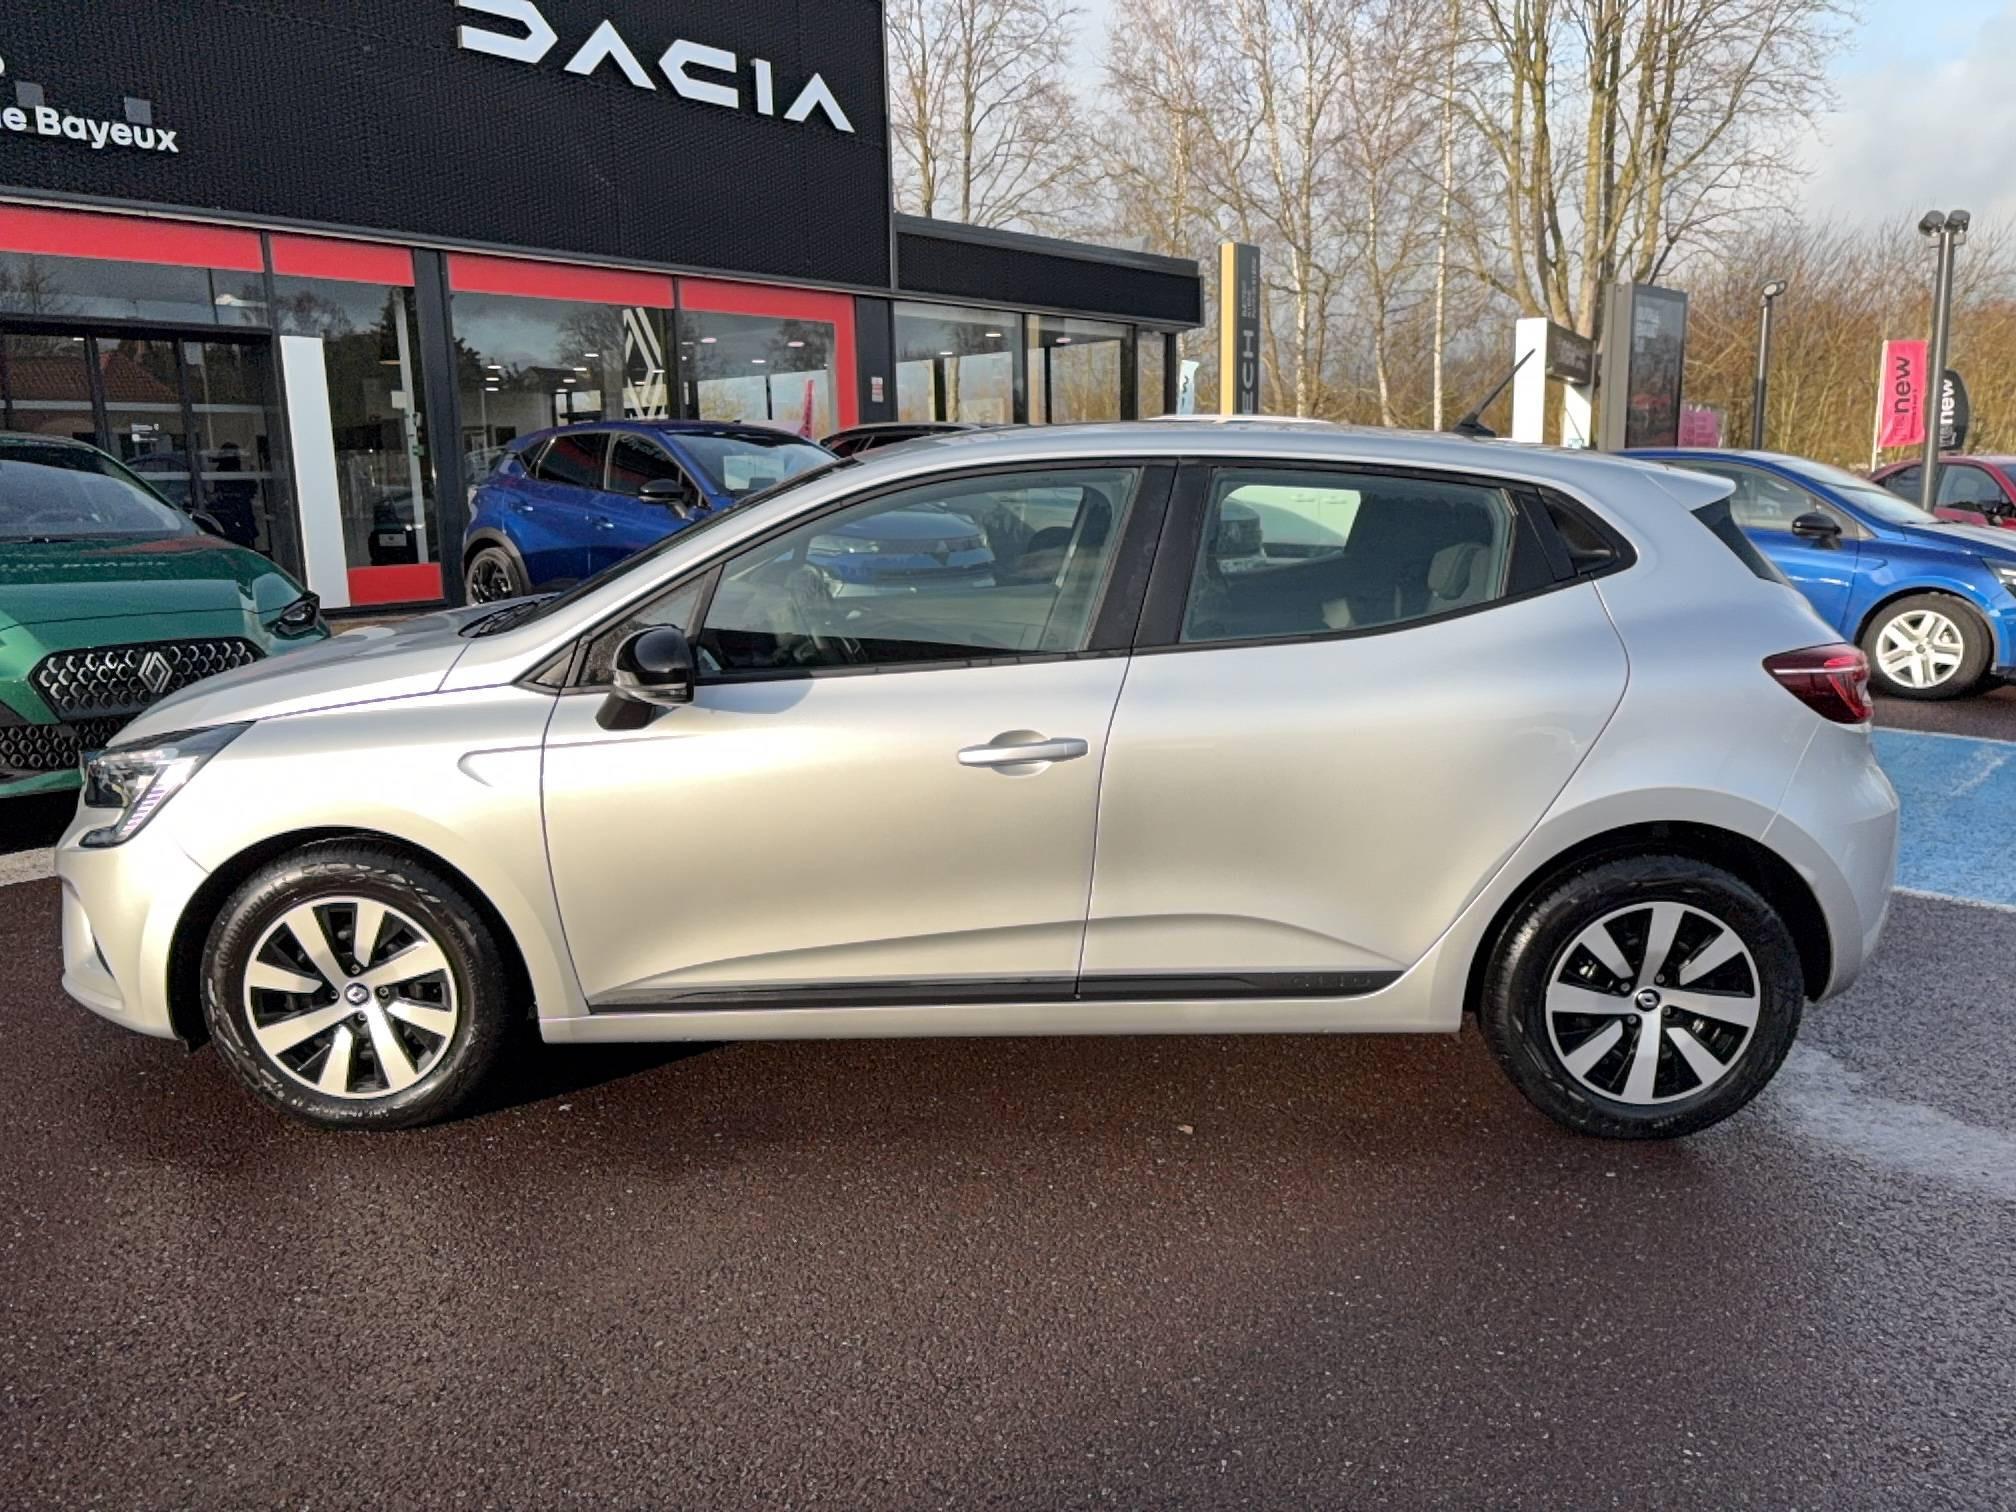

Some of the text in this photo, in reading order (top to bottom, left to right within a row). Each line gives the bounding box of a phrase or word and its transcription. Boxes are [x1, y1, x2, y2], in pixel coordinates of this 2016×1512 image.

[455, 0, 855, 133] DACIA
[0, 105, 179, 153] e Bayeux
